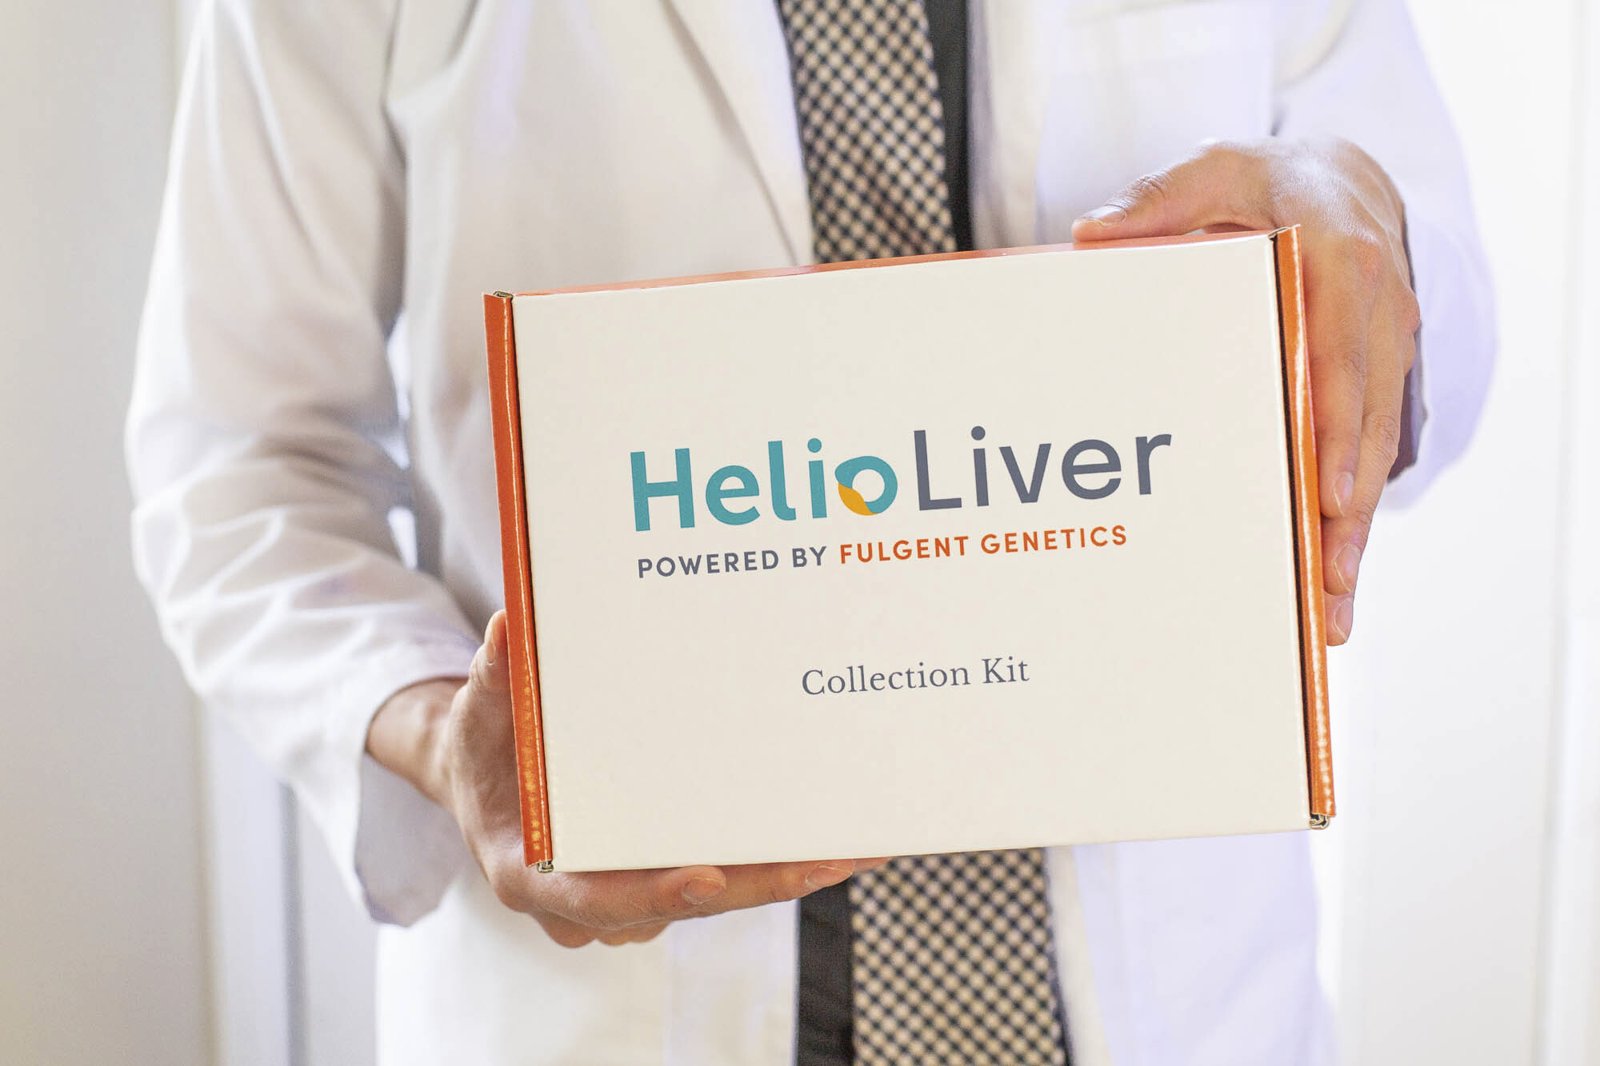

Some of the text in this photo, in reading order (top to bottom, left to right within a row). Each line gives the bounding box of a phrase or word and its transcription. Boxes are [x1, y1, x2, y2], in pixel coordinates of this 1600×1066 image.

[638, 525, 1126, 578] POWERED BY FULGENT GENETICS
[802, 655, 1030, 696] Collection Kit
